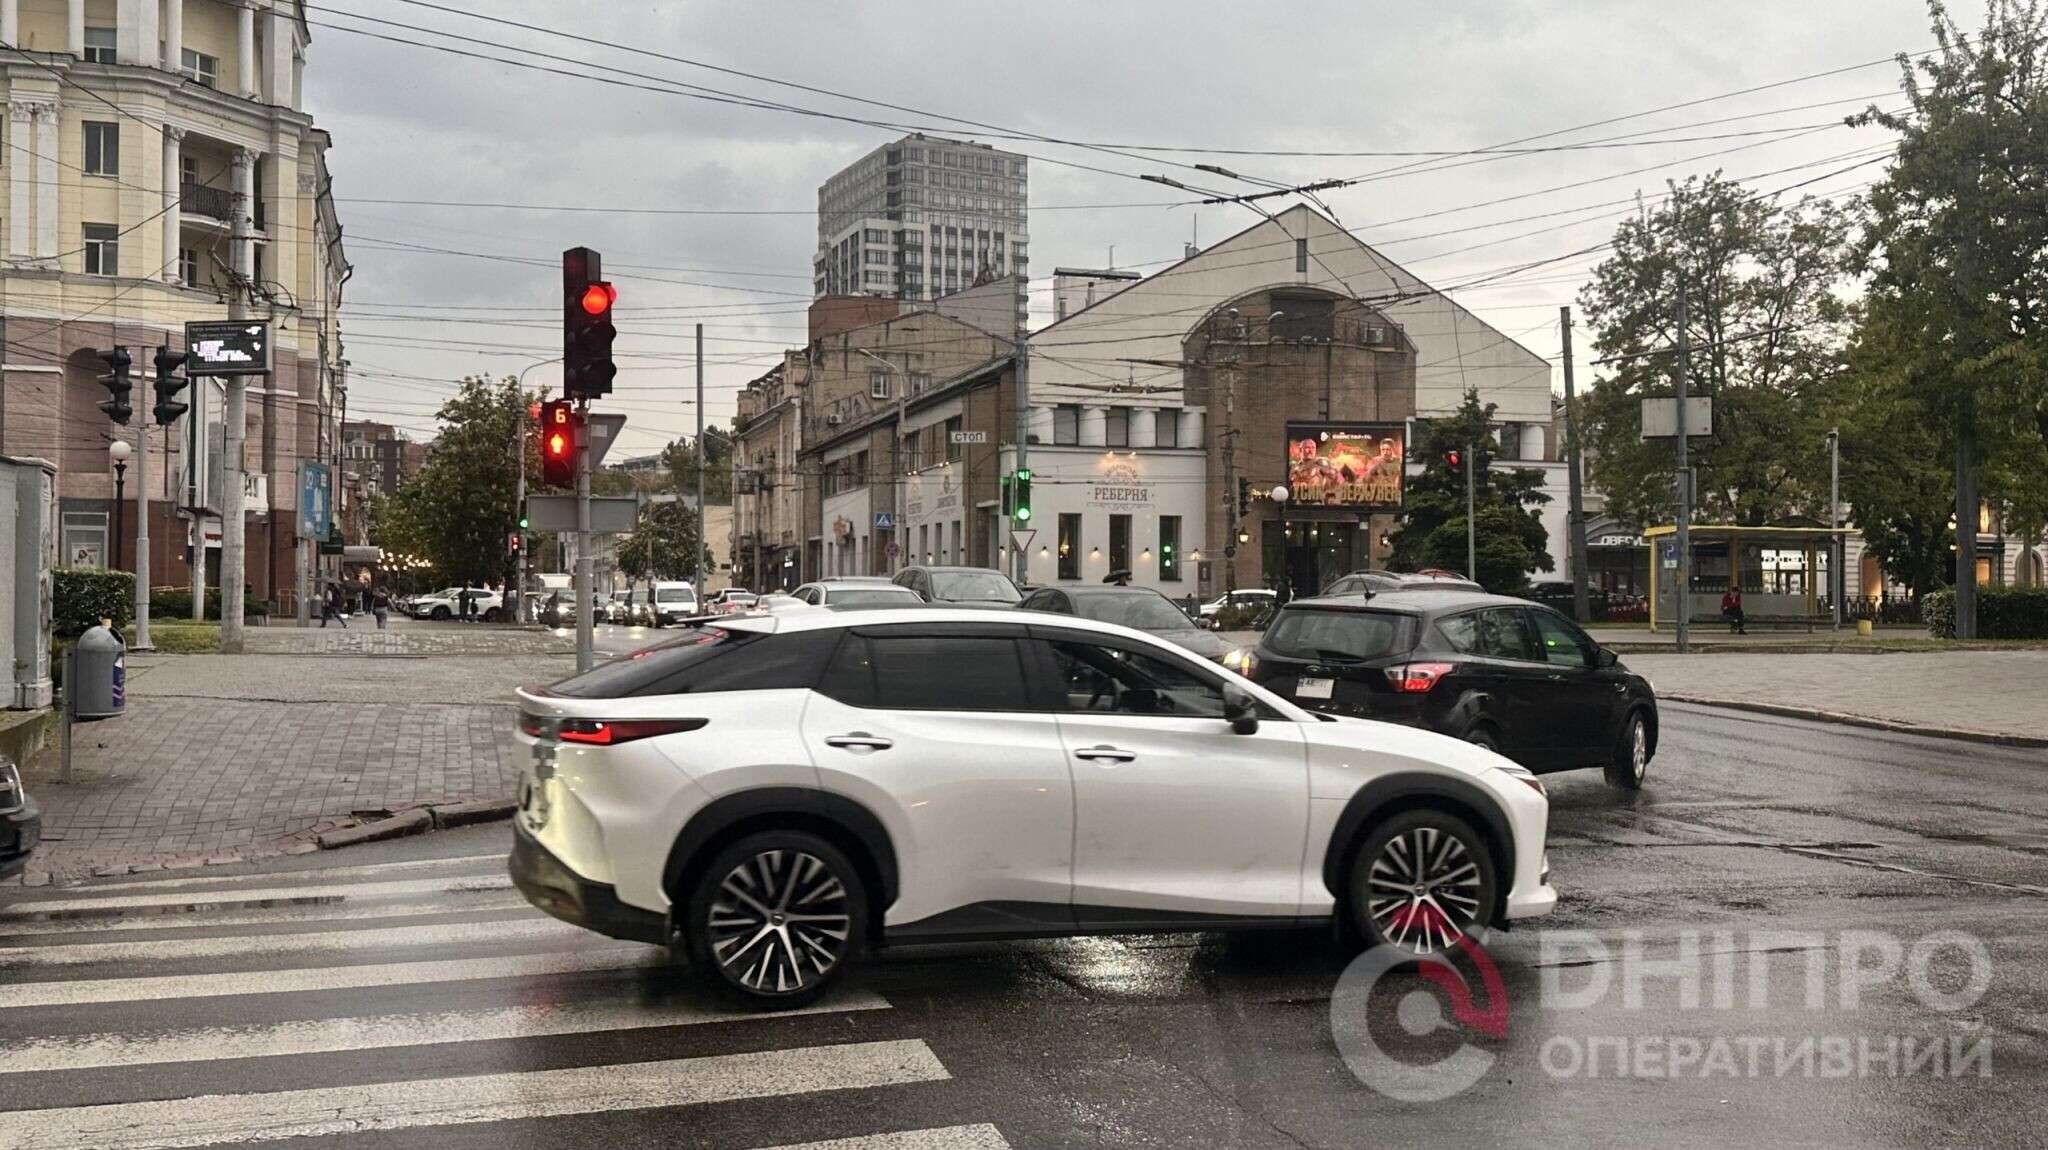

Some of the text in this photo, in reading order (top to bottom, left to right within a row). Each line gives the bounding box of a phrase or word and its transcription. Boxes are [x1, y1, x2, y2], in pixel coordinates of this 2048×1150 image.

[555, 408, 566, 423] 6
[955, 432, 983, 442] СТОП
[1094, 487, 1148, 501] РЕБЕРНЯ
